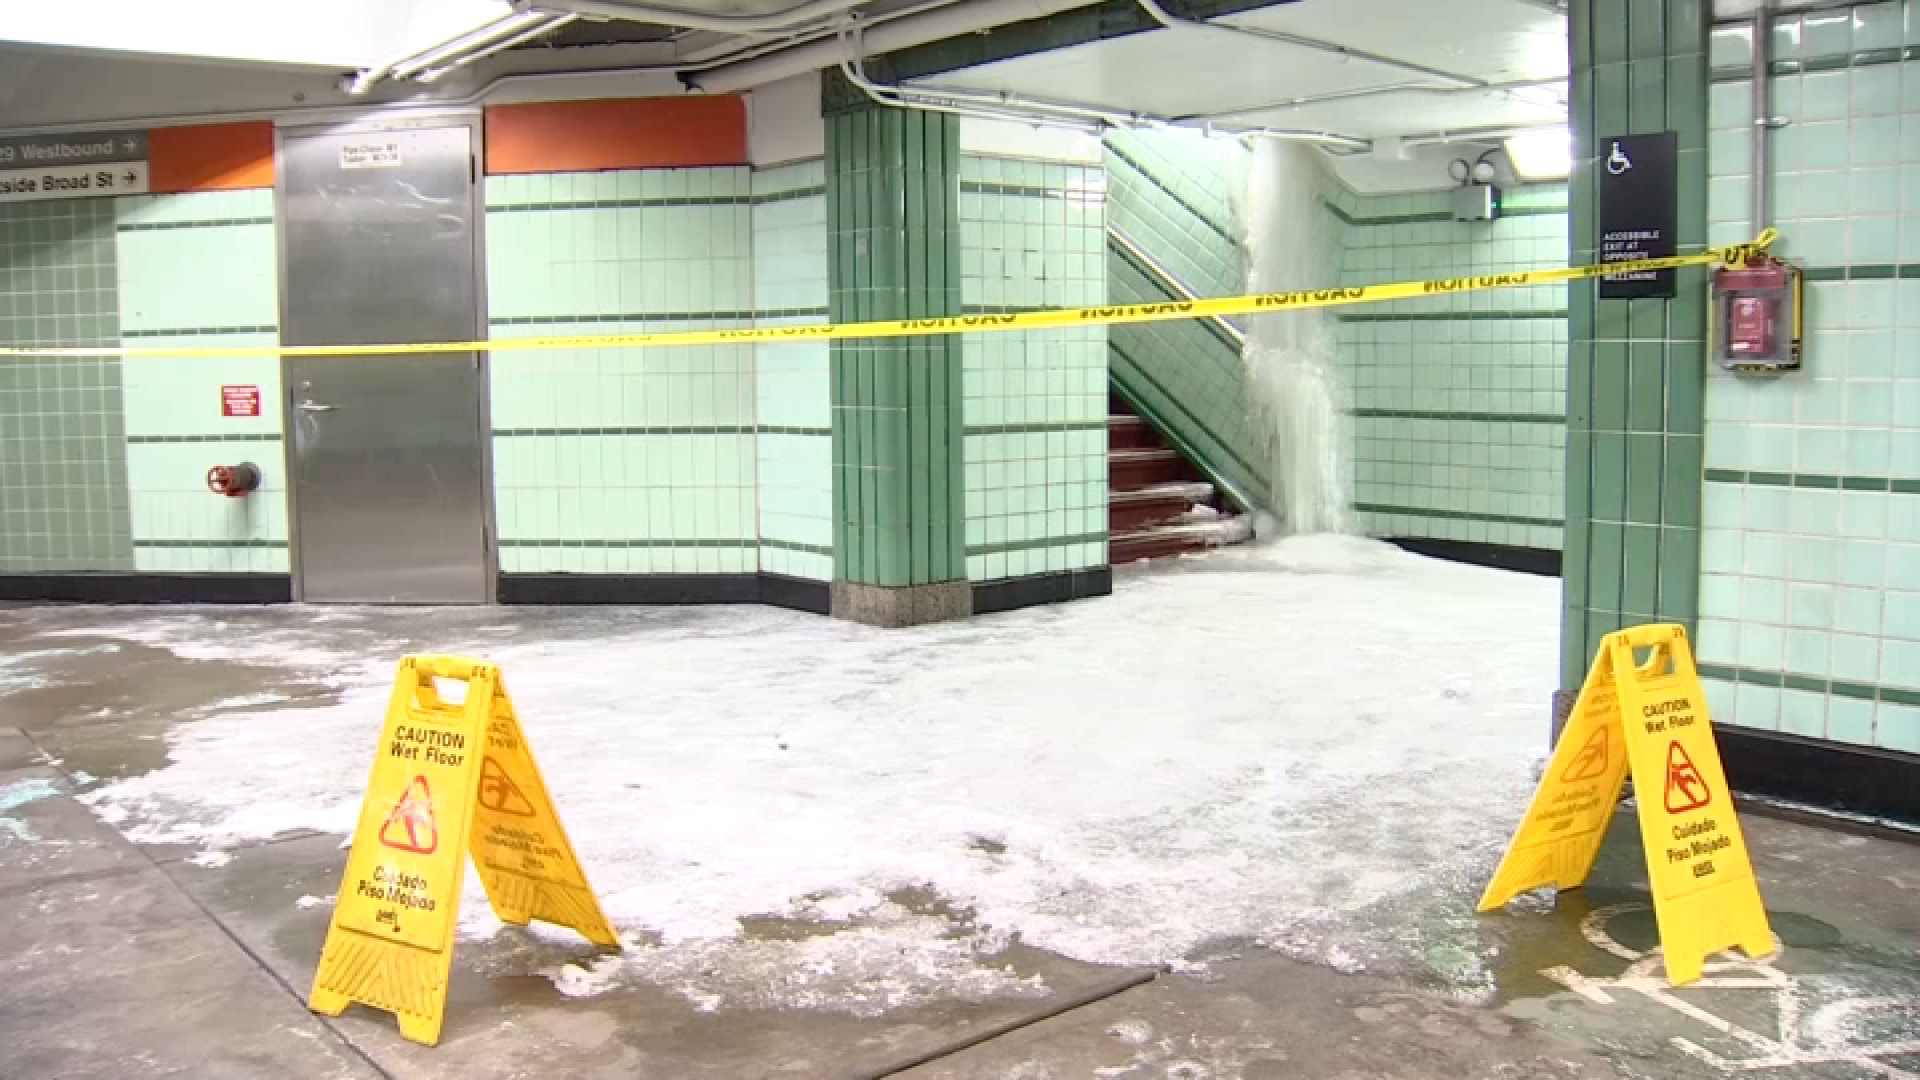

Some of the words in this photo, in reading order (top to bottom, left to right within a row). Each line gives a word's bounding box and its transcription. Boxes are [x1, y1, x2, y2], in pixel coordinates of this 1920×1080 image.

[21, 139, 113, 159] Westbound
[42, 172, 89, 190] Broad
[96, 171, 113, 188] St
[1642, 698, 1691, 718] CAUTION
[1644, 719, 1666, 735] Wet
[1668, 714, 1696, 729] Floor
[395, 726, 465, 749] CAUTION
[390, 741, 420, 760] Wet
[425, 747, 465, 766] Floor
[1671, 817, 1717, 840] Cuidado
[1666, 847, 1691, 864] Piso
[1691, 834, 1732, 857] Mojado
[357, 879, 385, 900] Piso
